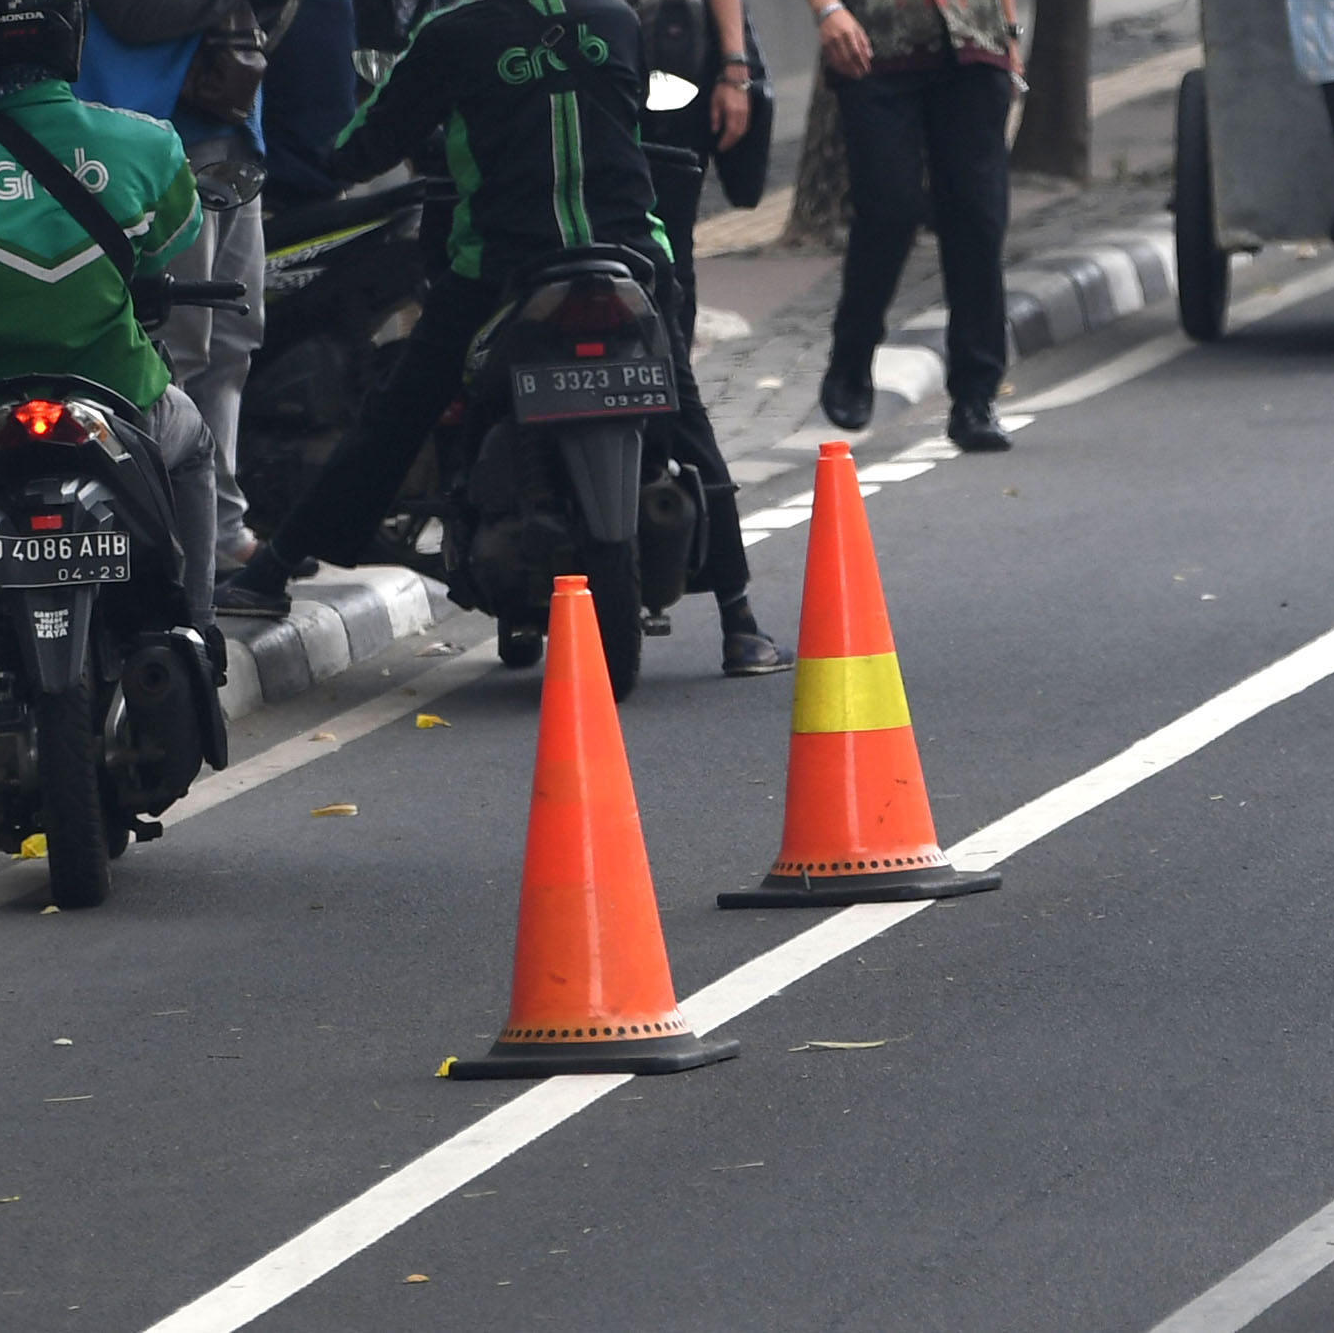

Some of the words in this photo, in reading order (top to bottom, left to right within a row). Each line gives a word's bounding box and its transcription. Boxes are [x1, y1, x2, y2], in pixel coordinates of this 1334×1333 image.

[522, 375, 536, 393] B
[553, 370, 610, 390] 3323
[623, 366, 665, 386] PGE
[12, 538, 72, 561] 4086
[79, 535, 126, 557] AHB
[37, 628, 68, 638] KAYA
